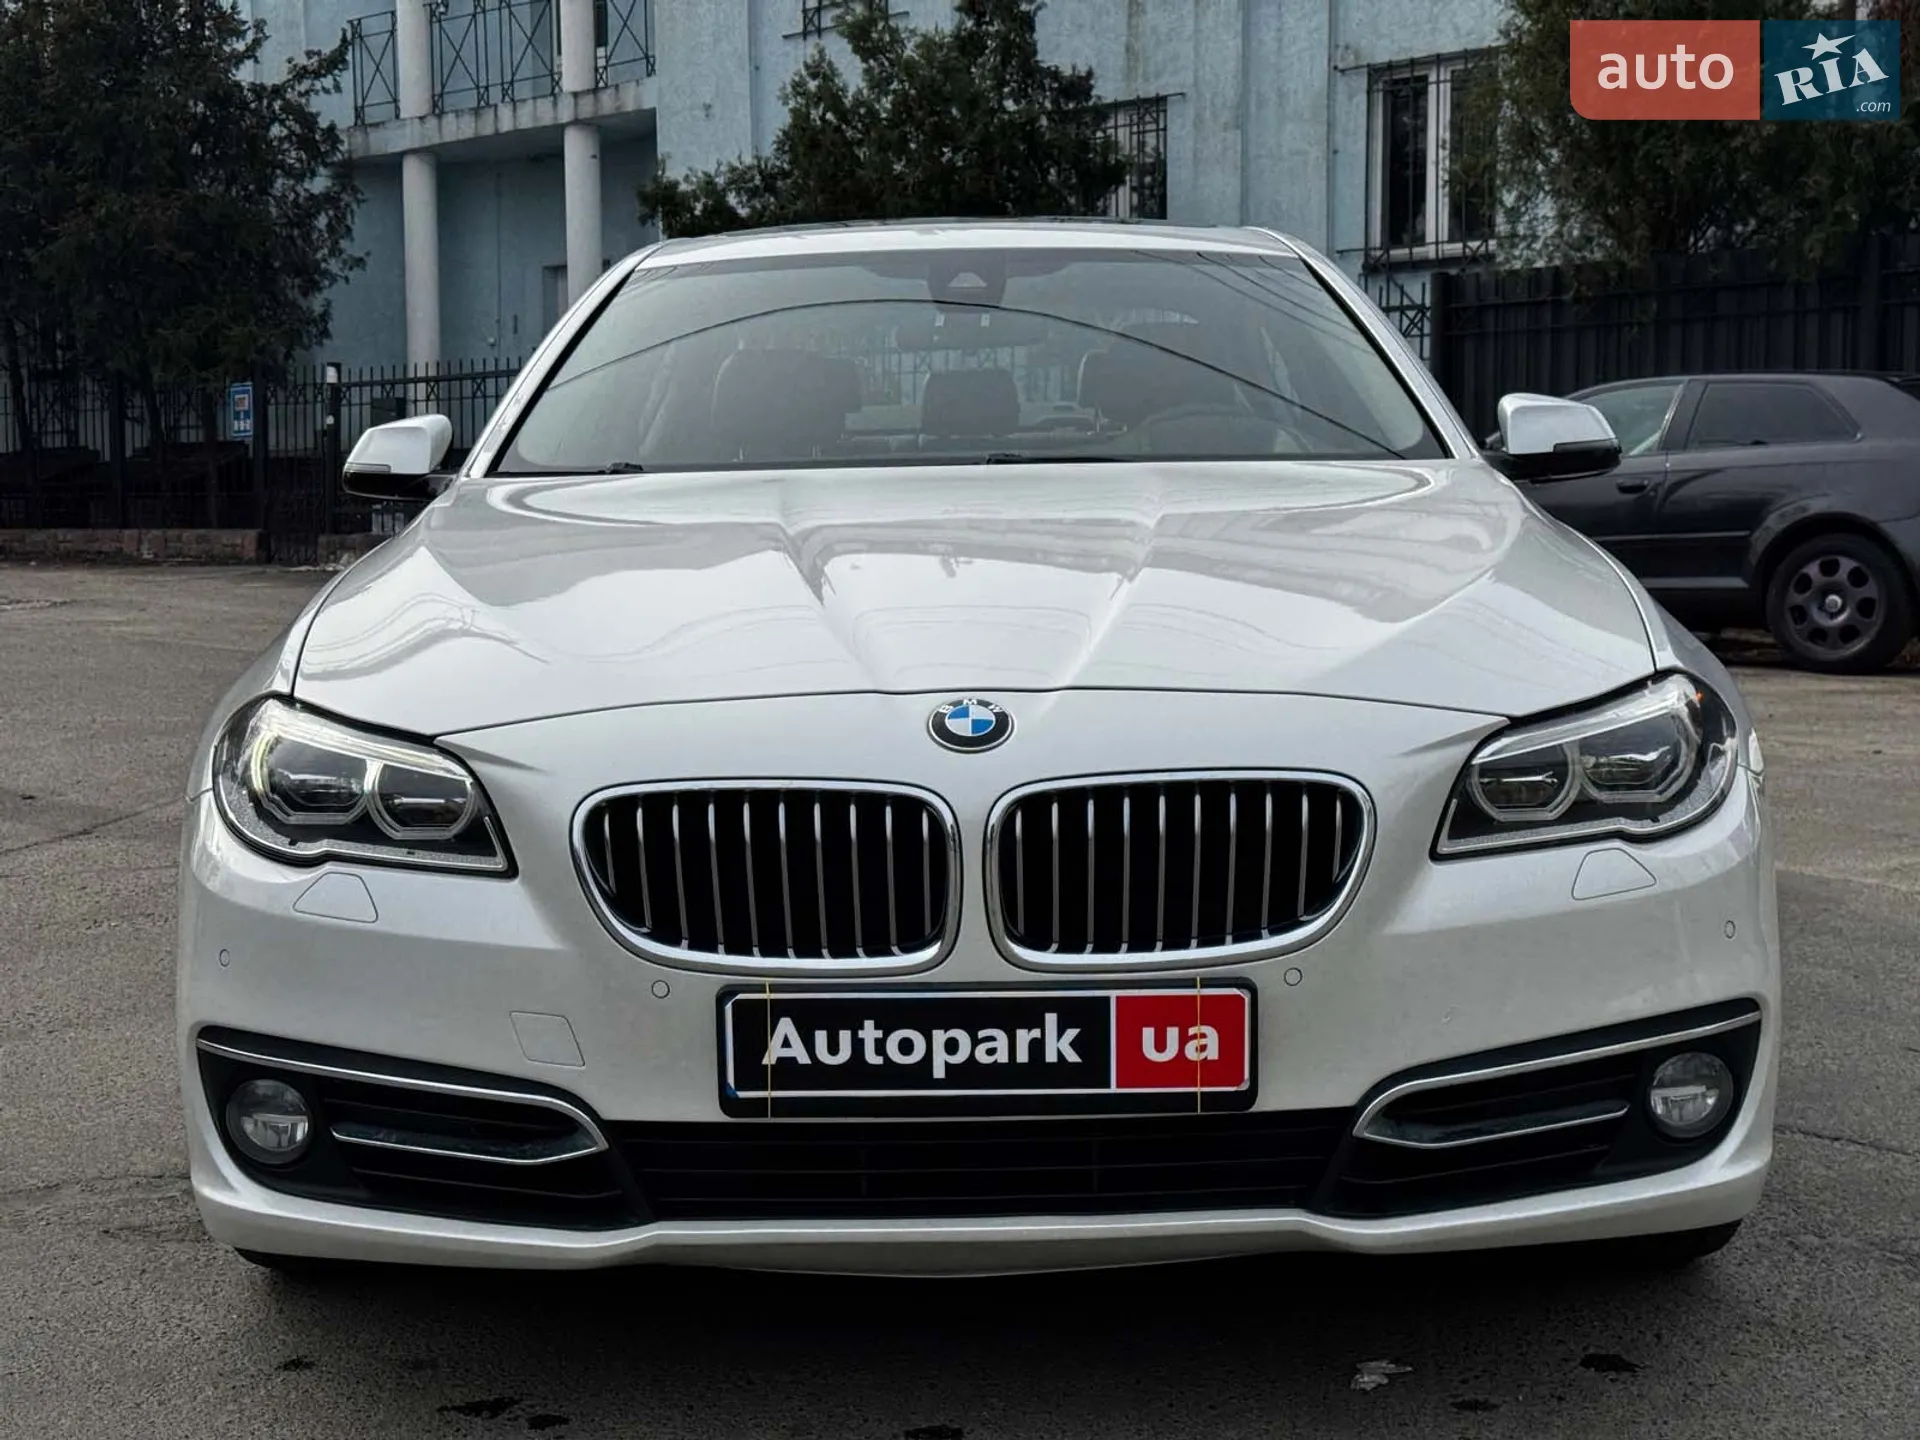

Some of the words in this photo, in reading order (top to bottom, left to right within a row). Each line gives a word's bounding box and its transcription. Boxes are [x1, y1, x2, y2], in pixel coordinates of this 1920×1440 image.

[939, 699, 1005, 713] BMW
[761, 1012, 1082, 1079] Autopark
[1142, 1024, 1219, 1063] ua
